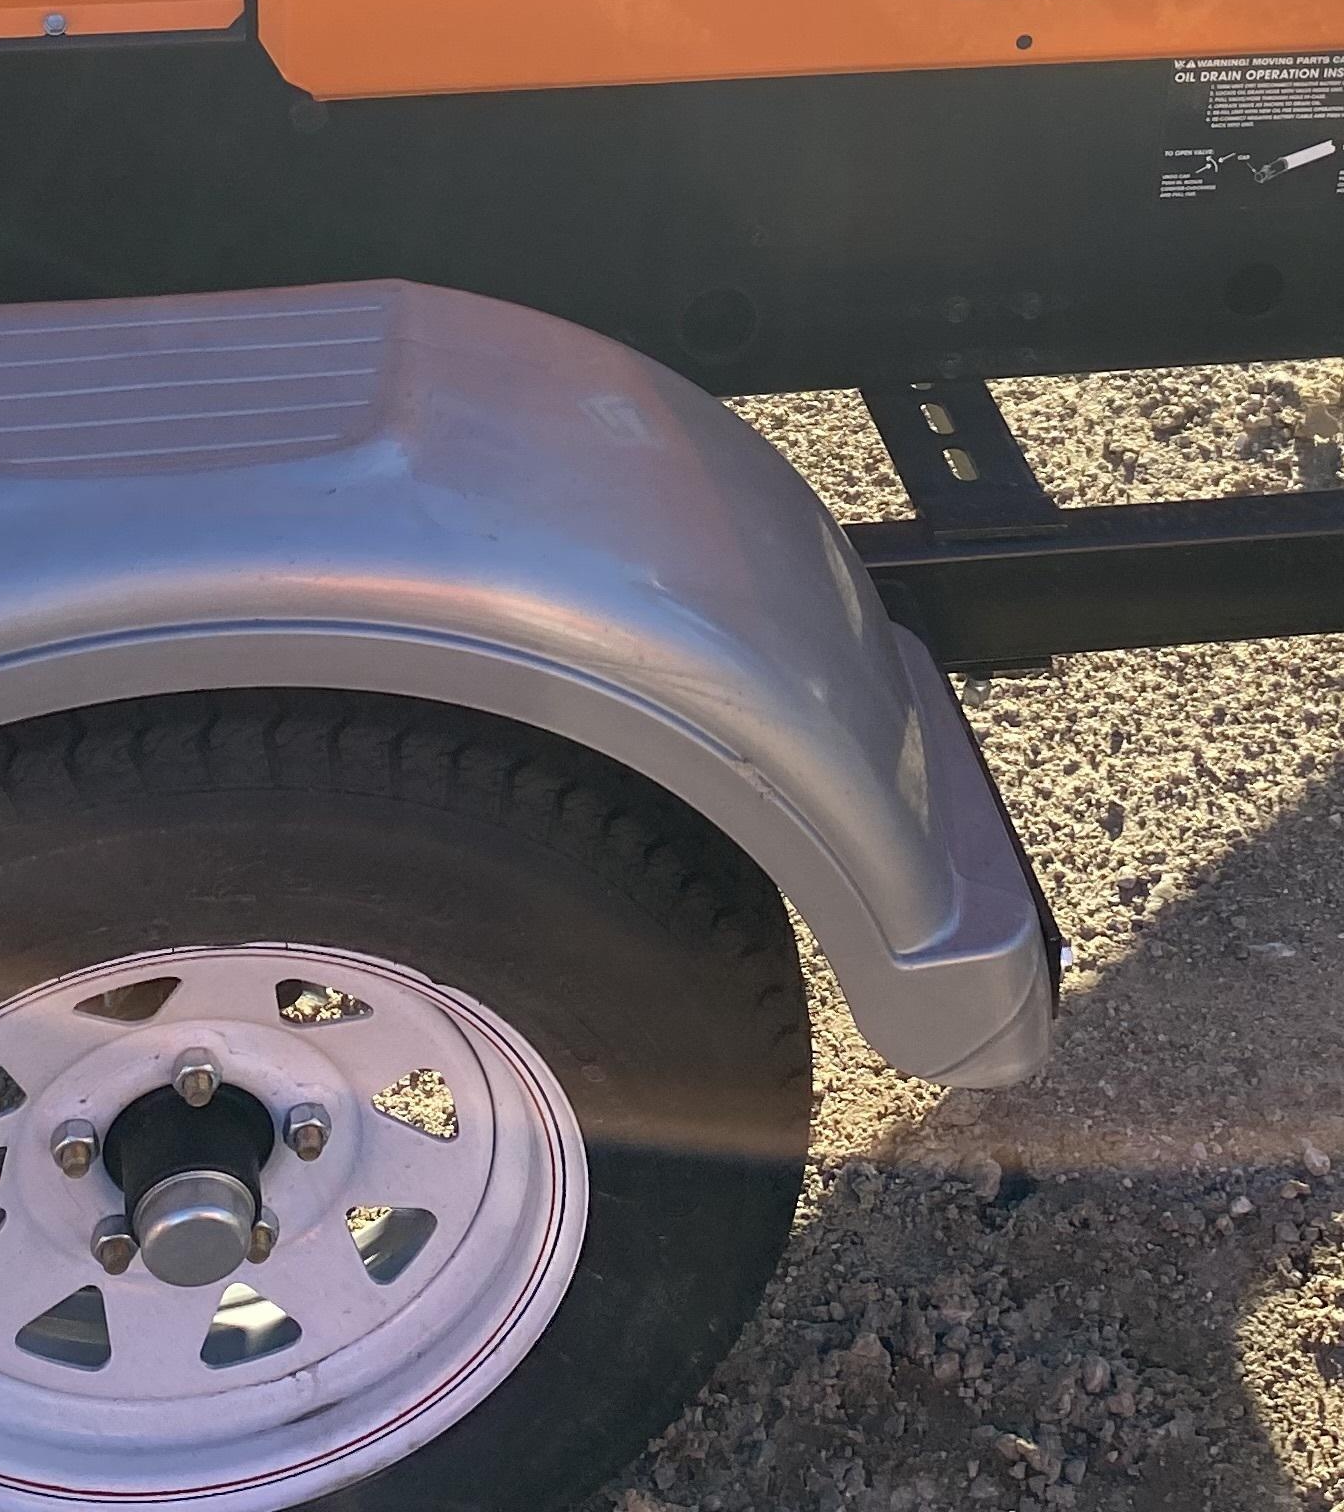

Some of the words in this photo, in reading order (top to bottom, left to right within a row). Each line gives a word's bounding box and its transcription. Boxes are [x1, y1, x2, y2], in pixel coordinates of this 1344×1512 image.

[1197, 58, 1249, 68] WARNING!
[1251, 56, 1294, 66] MOVING
[1295, 55, 1330, 65] PARTS
[1174, 71, 1197, 83] OIL
[1200, 70, 1242, 82] DRAIN
[1245, 67, 1320, 81] OPERATION
